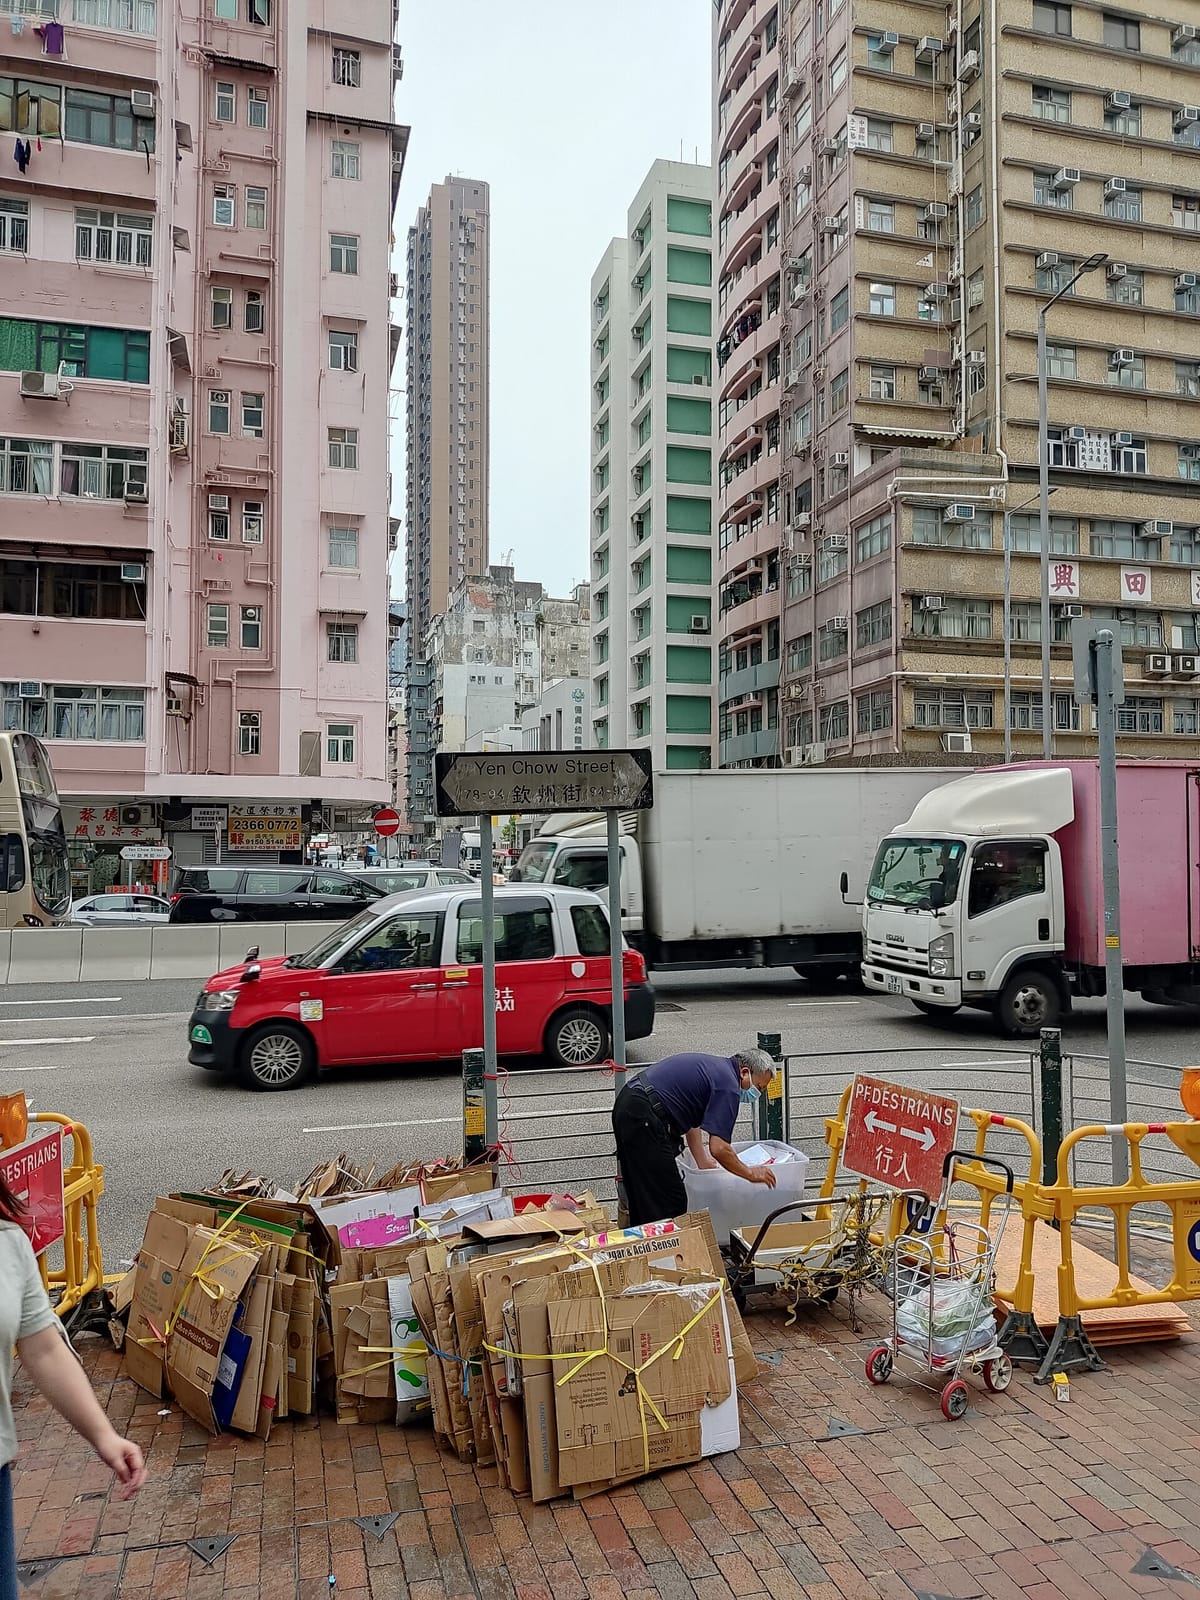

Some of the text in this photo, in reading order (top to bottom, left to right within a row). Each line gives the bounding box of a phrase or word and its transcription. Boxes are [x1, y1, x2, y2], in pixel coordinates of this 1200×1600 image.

[474, 758, 616, 775] Yen Chow Street
[512, 784, 581, 804] 欽州街
[233, 820, 298, 831] 2366 0772
[495, 999, 515, 1012] AXI
[855, 1083, 954, 1126] PEDESTRIANS
[875, 1144, 911, 1183] 行人
[626, 1248, 633, 1256] &
[633, 1243, 652, 1256] Acid
[651, 1237, 680, 1252] Sensor
